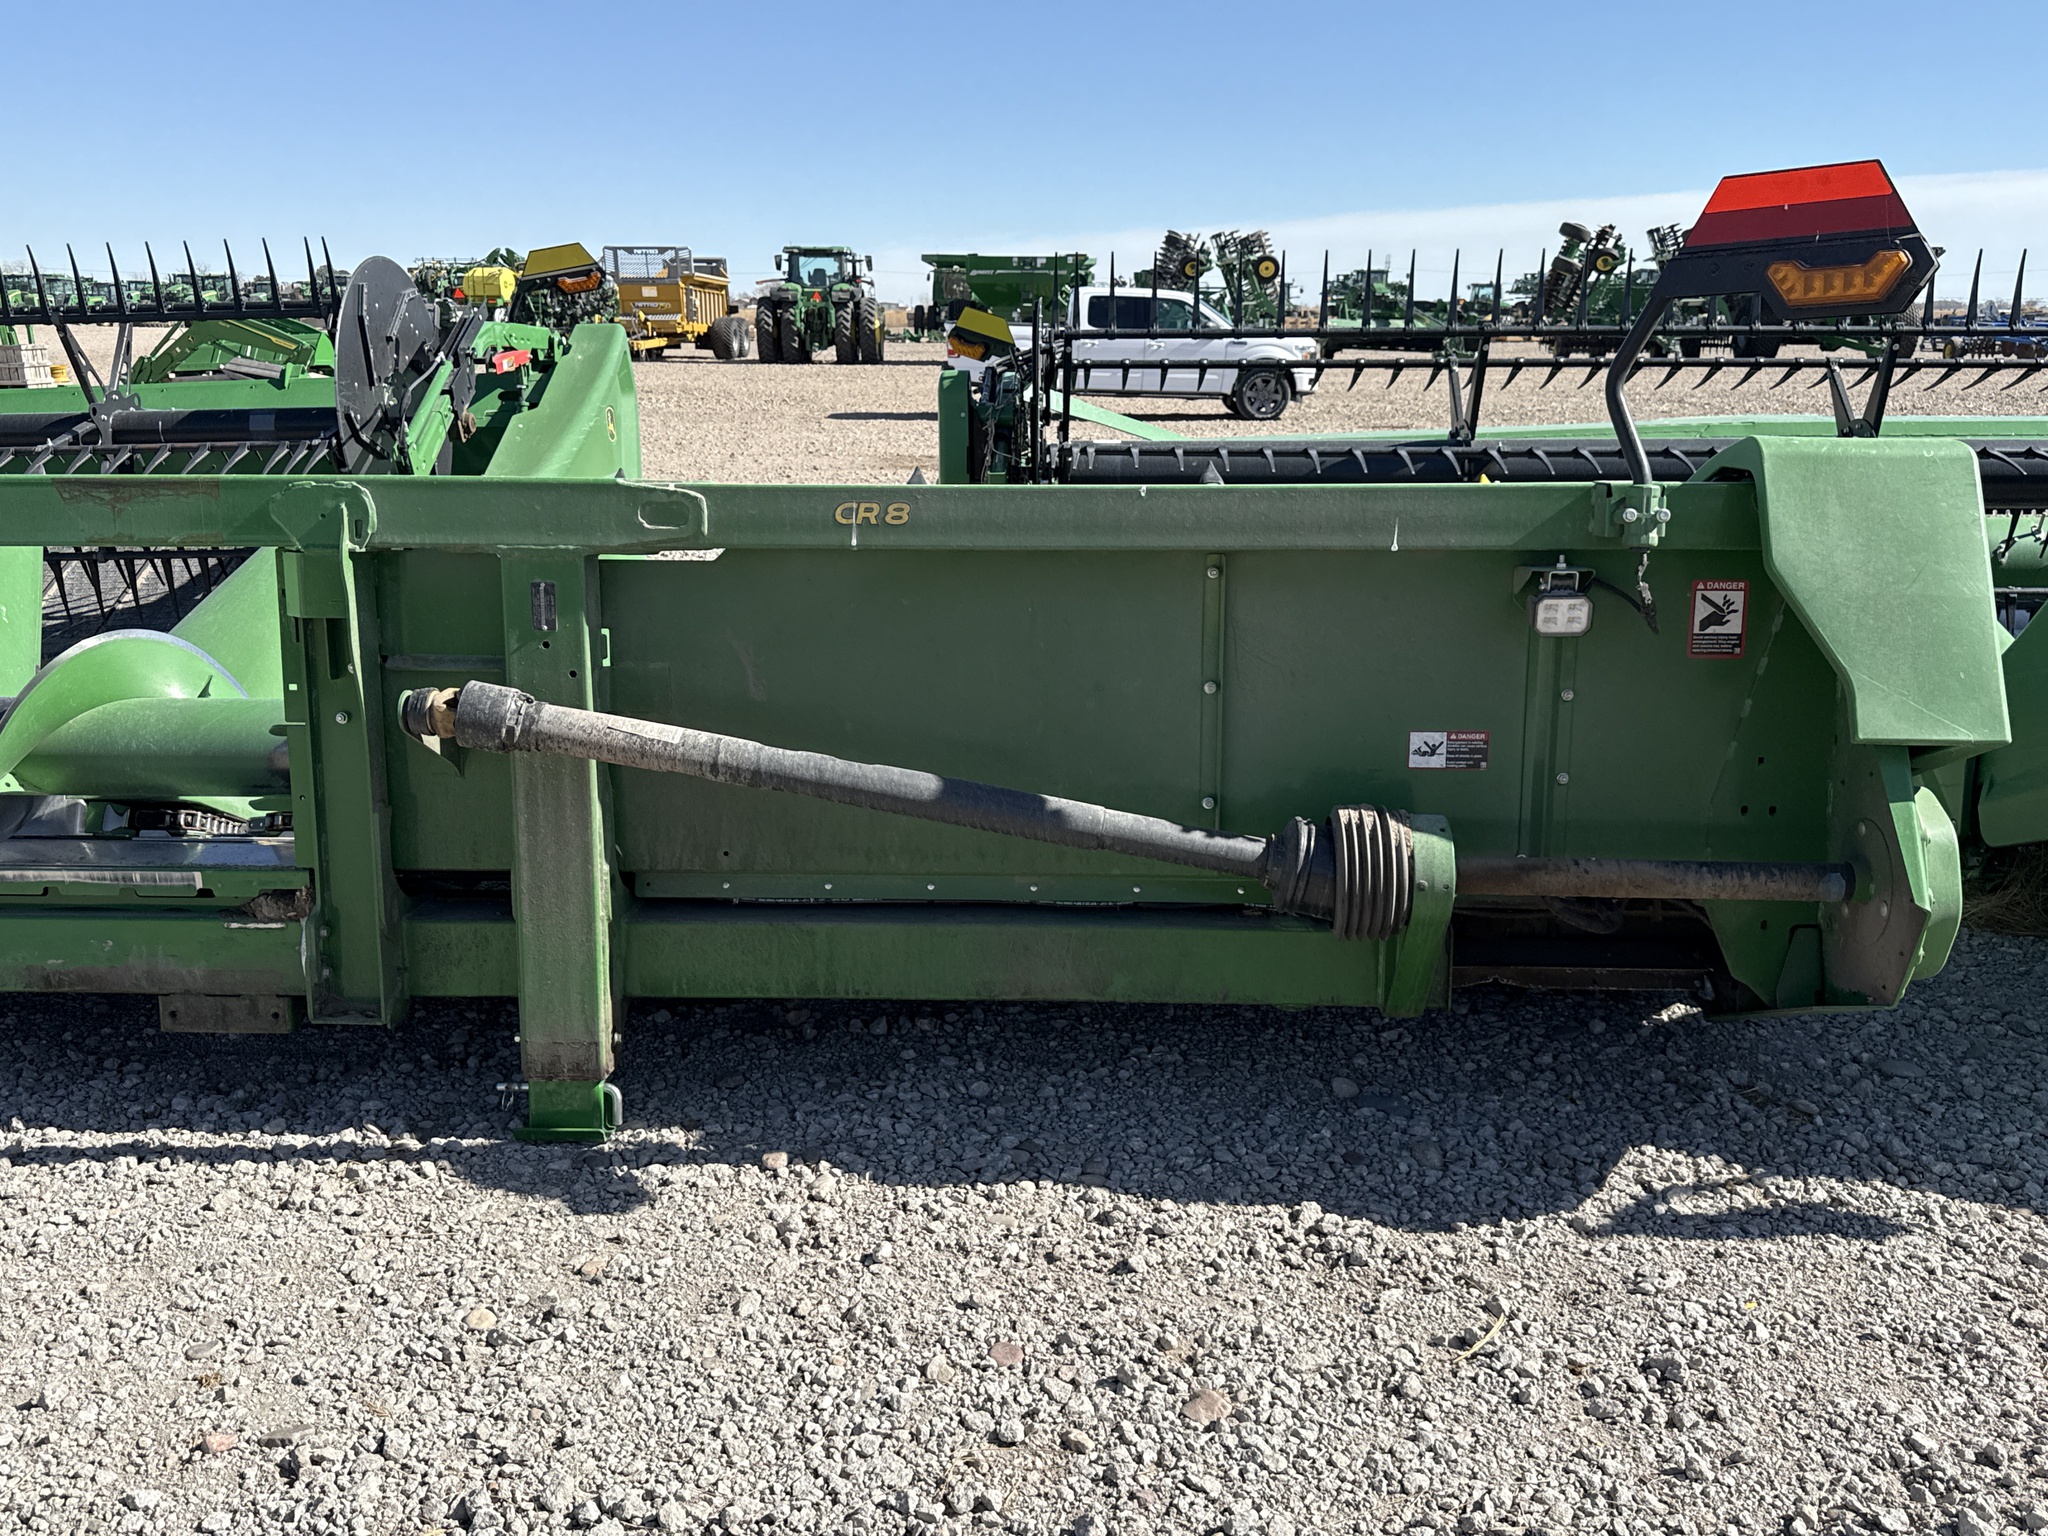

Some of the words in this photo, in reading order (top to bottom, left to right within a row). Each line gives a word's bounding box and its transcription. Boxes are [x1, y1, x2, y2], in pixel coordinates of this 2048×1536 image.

[835, 501, 880, 525] CR
[885, 501, 911, 525] 8
[1706, 581, 1745, 590] DANGER
